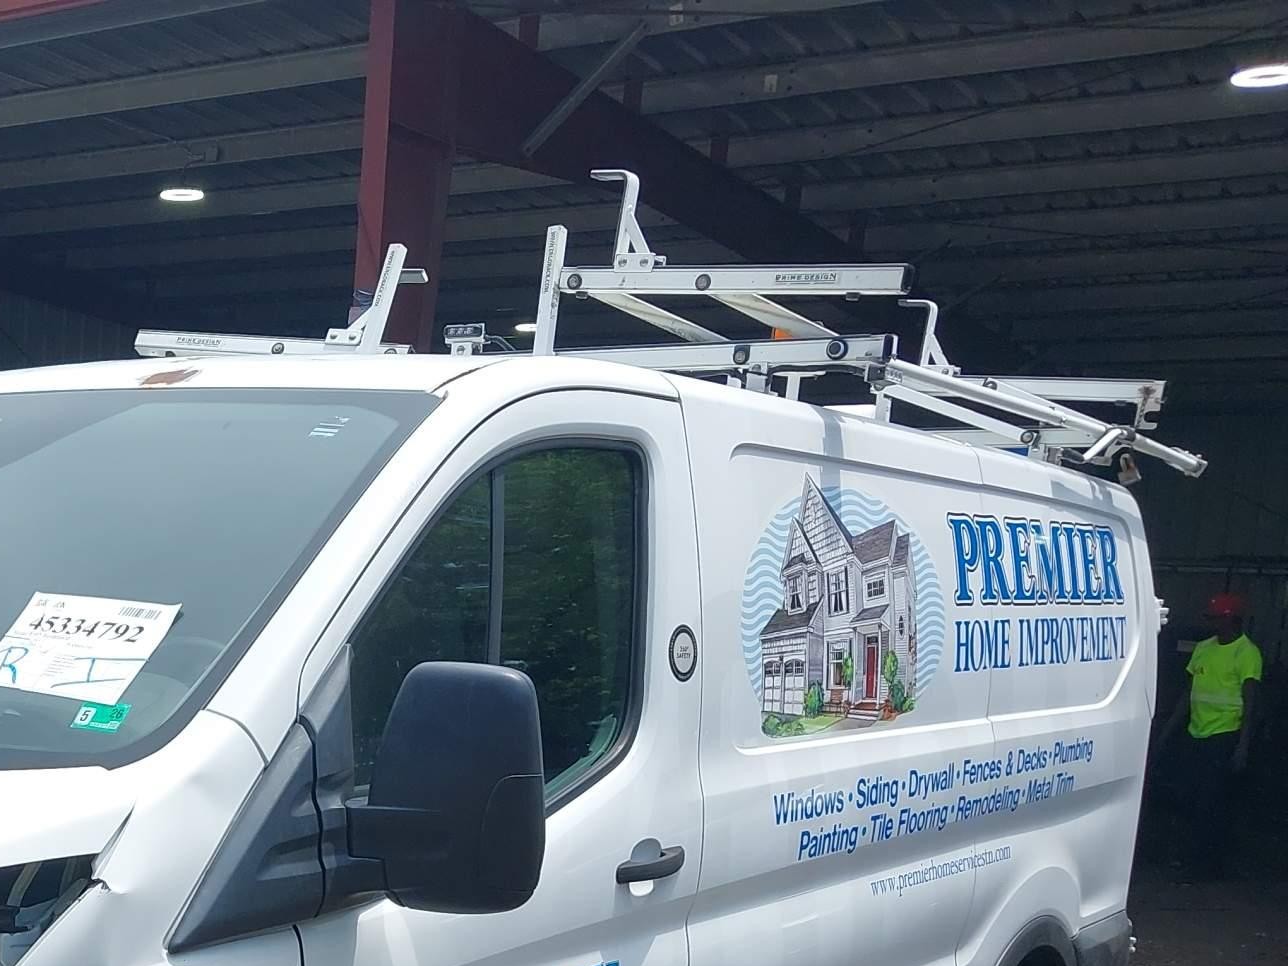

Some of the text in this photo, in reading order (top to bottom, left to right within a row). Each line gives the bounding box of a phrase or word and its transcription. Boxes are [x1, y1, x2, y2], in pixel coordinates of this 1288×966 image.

[947, 512, 1124, 606] PREMIER
[29, 614, 145, 643] 45334792
[954, 616, 1127, 672] HOME IMPROVEMENT
[79, 710, 92, 722] 5
[774, 737, 1093, 825] Windows Siding Drywall Fences & Decks Plumbing
[798, 772, 1074, 861] Painting Tile Flooring Remodeling Metal Trim
[871, 845, 1011, 897] www.premierhomeservicestn.com
